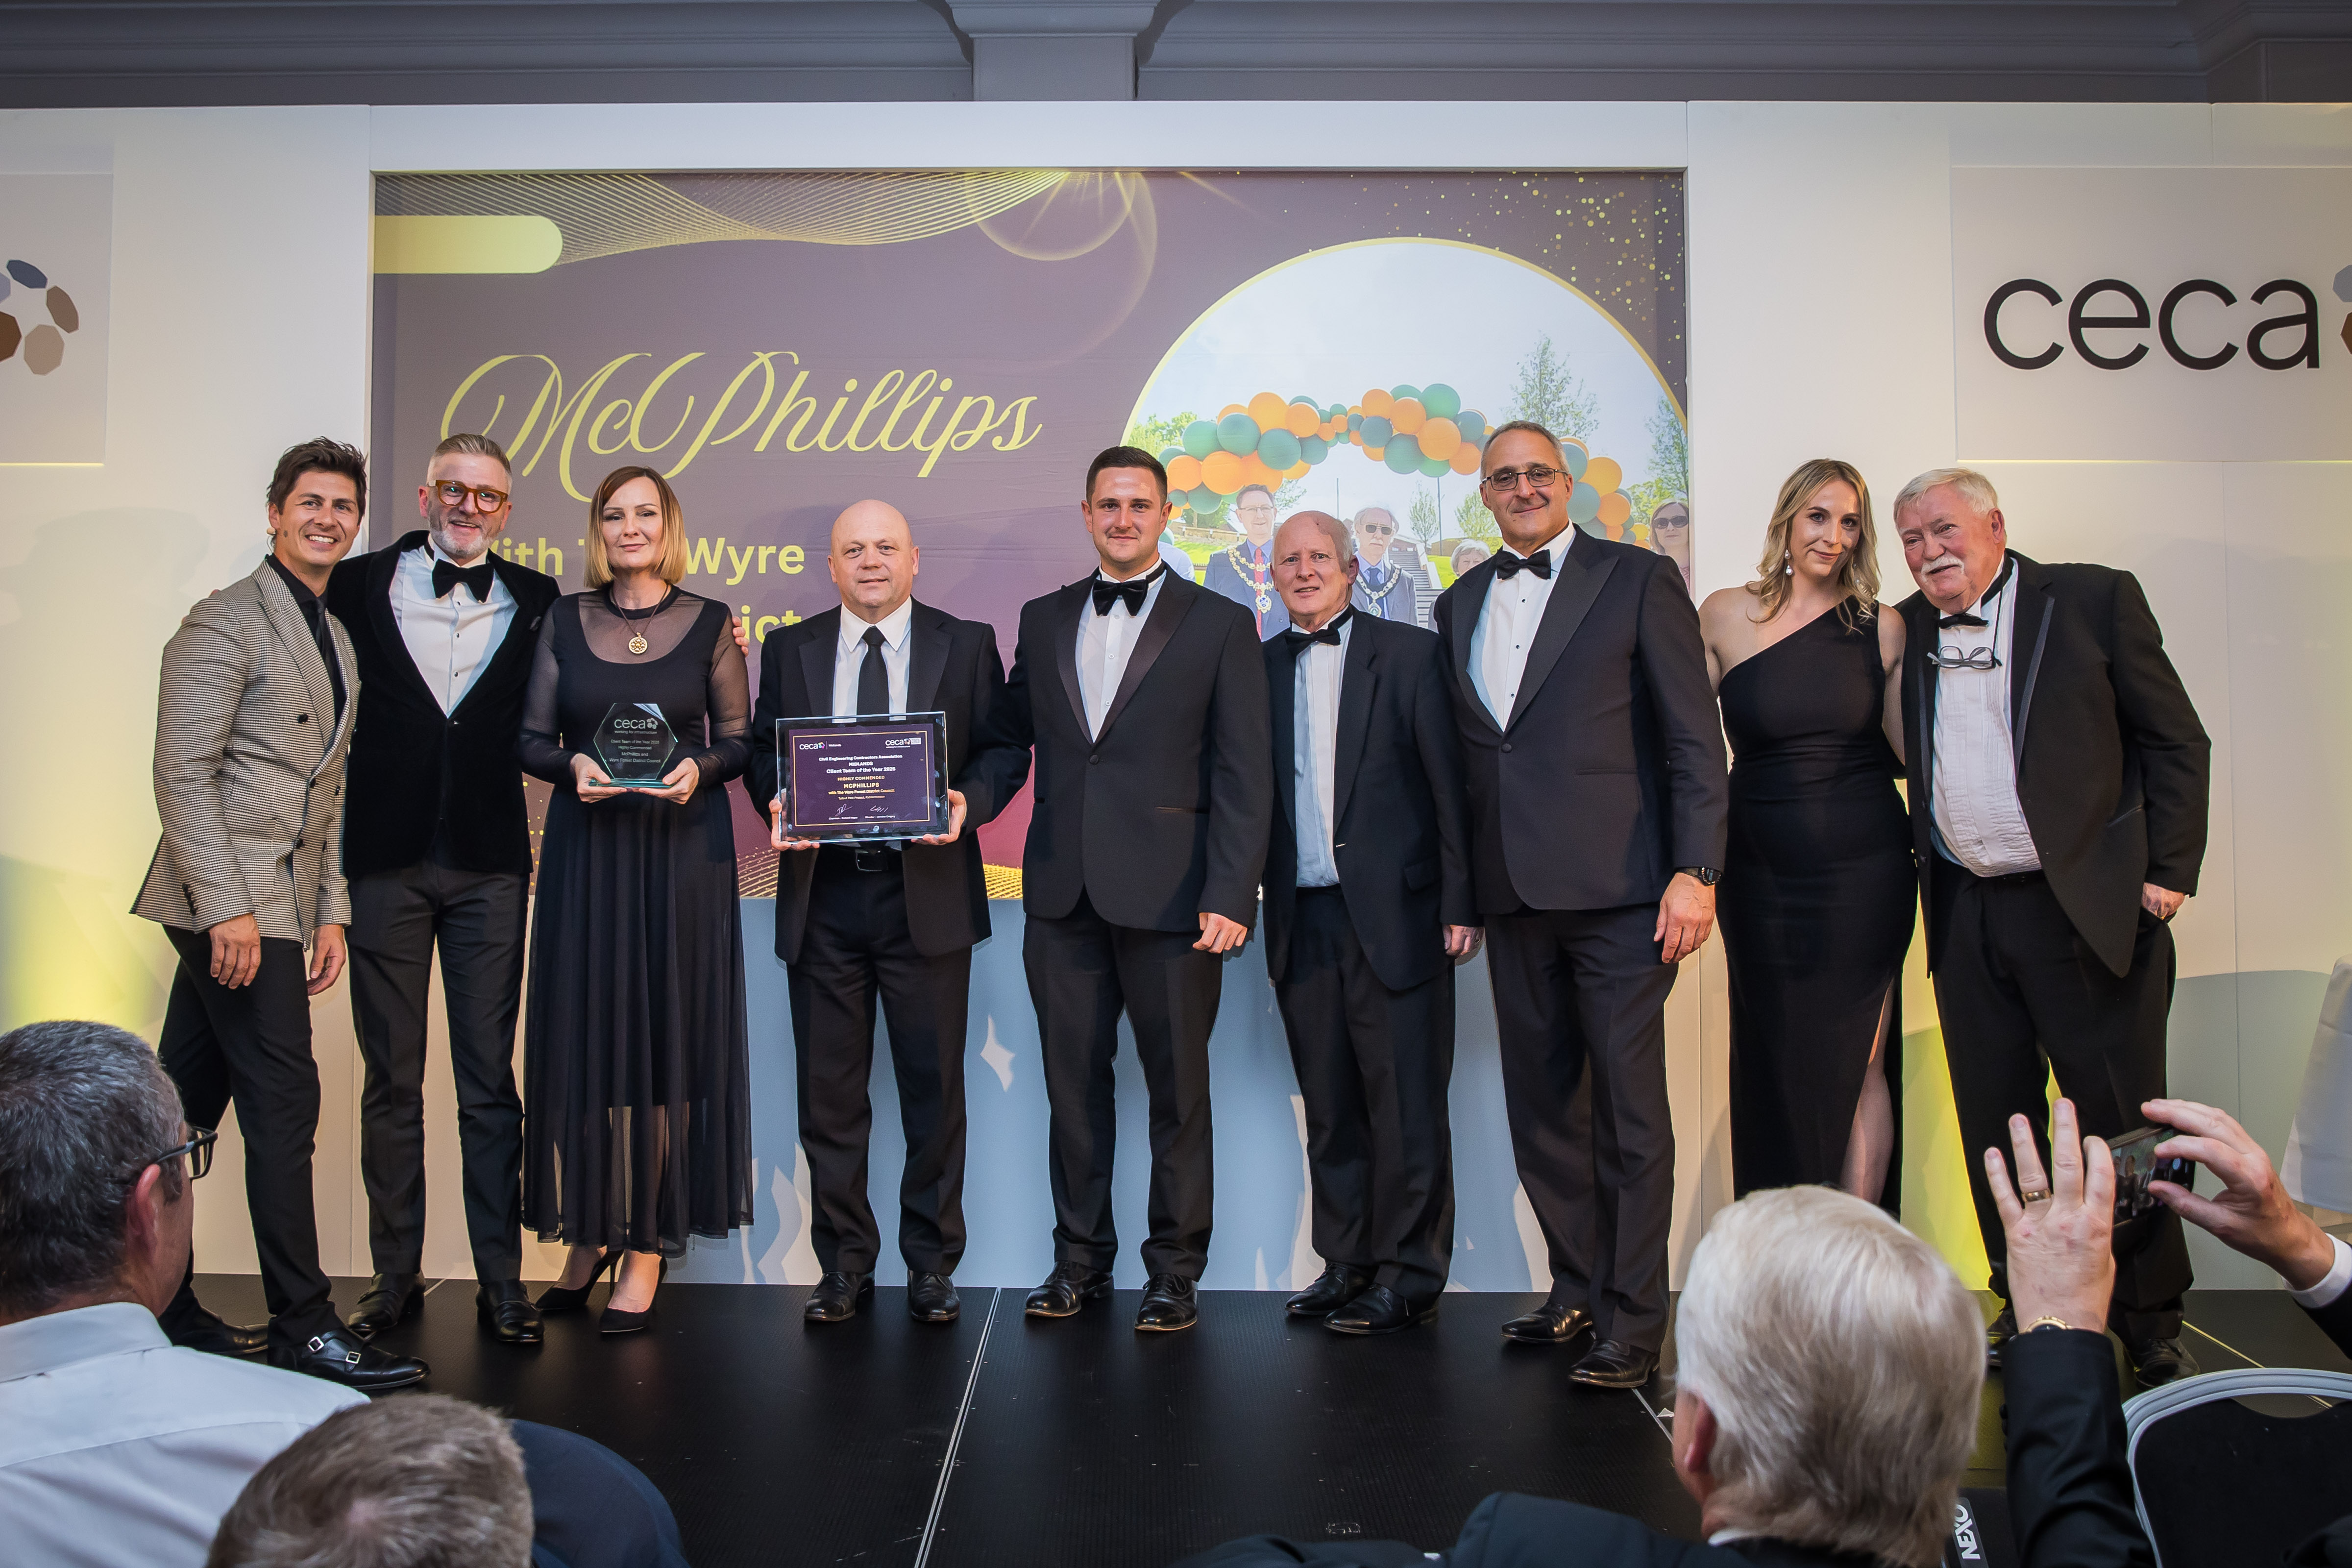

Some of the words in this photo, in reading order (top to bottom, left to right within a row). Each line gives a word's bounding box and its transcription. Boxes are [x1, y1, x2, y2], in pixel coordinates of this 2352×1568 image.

[1983, 278, 2320, 371] ceca
[441, 351, 1043, 502] McPhillips
[491, 537, 563, 575] ith
[686, 538, 805, 586] Wyre
[614, 719, 646, 729] ceca
[1953, 1504, 1981, 1560] NEXO
